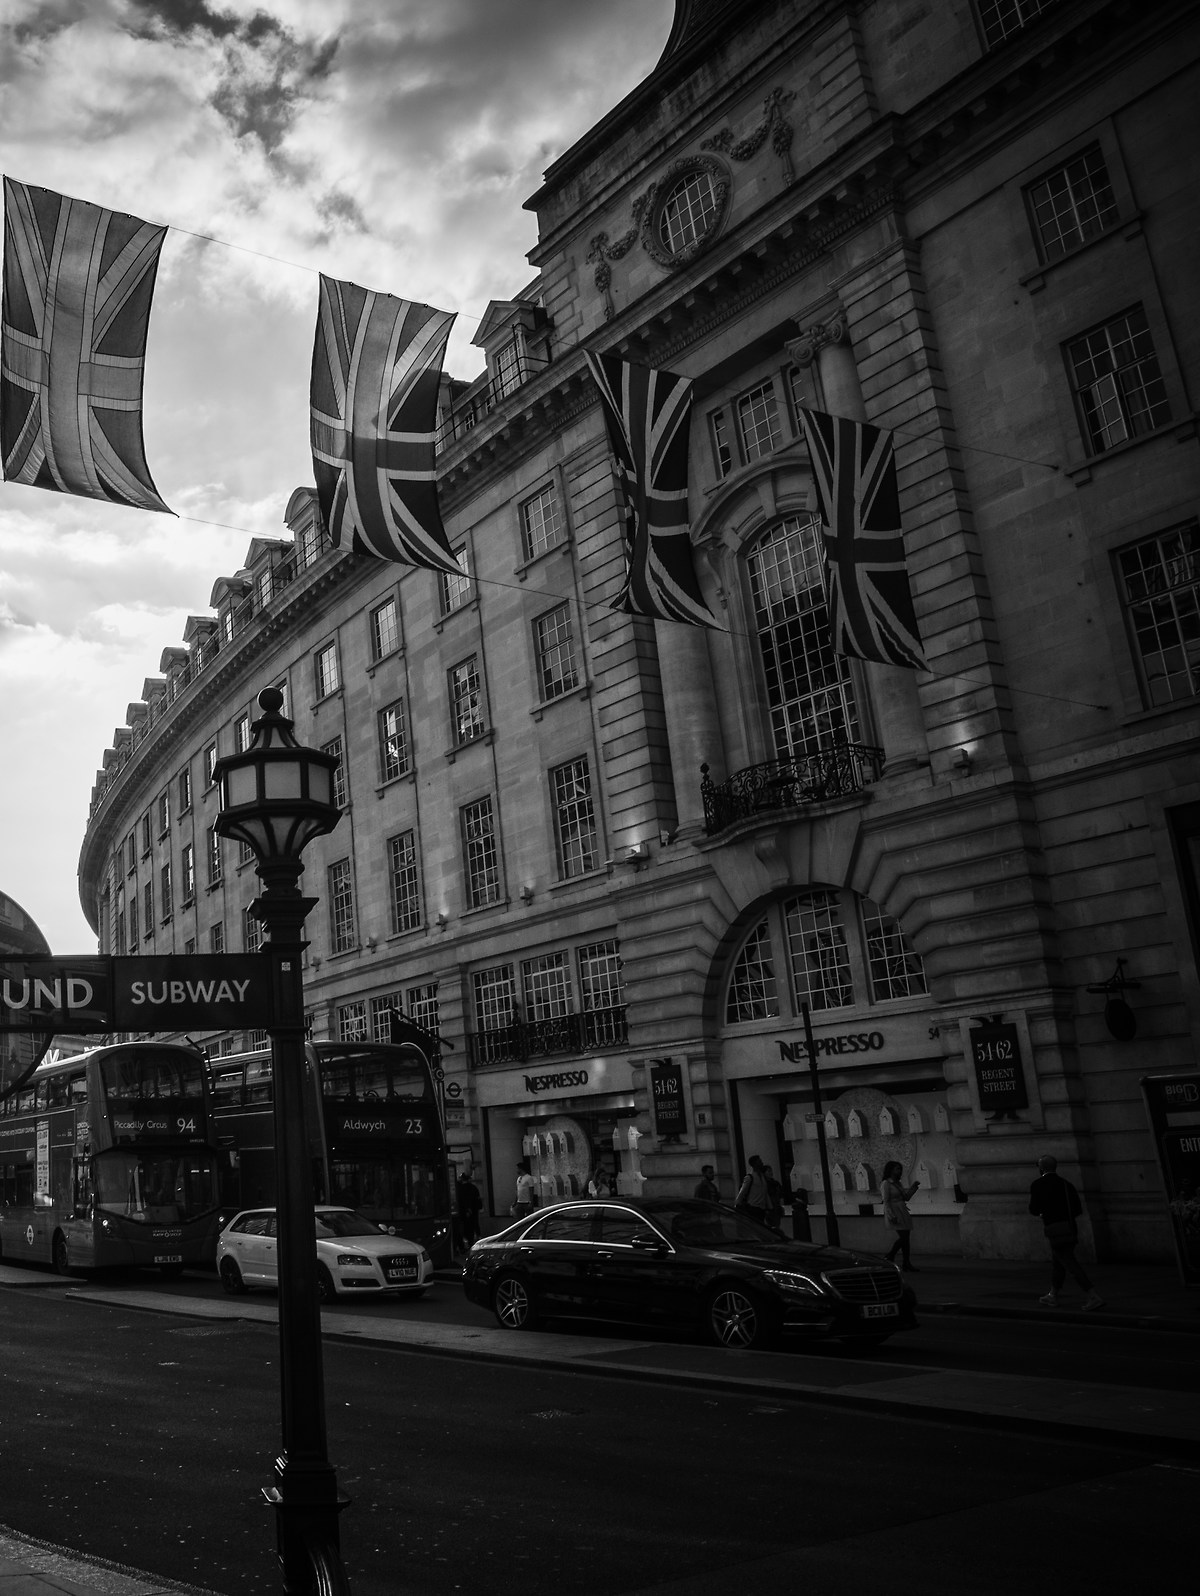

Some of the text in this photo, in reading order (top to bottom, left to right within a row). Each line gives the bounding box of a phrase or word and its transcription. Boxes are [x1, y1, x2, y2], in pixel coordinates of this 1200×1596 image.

[131, 980, 250, 1005] SUBWAY
[929, 1028, 940, 1040] 54
[981, 1068, 1015, 1080] REGENT
[523, 1070, 588, 1094] NESPRESSO
[984, 1081, 1017, 1093] STREET
[1165, 1084, 1184, 1095] BIG
[114, 1118, 197, 1133] Piccadilly Circus 94
[343, 1119, 422, 1134] Aldwych 23
[1180, 1138, 1200, 1153] ENT
